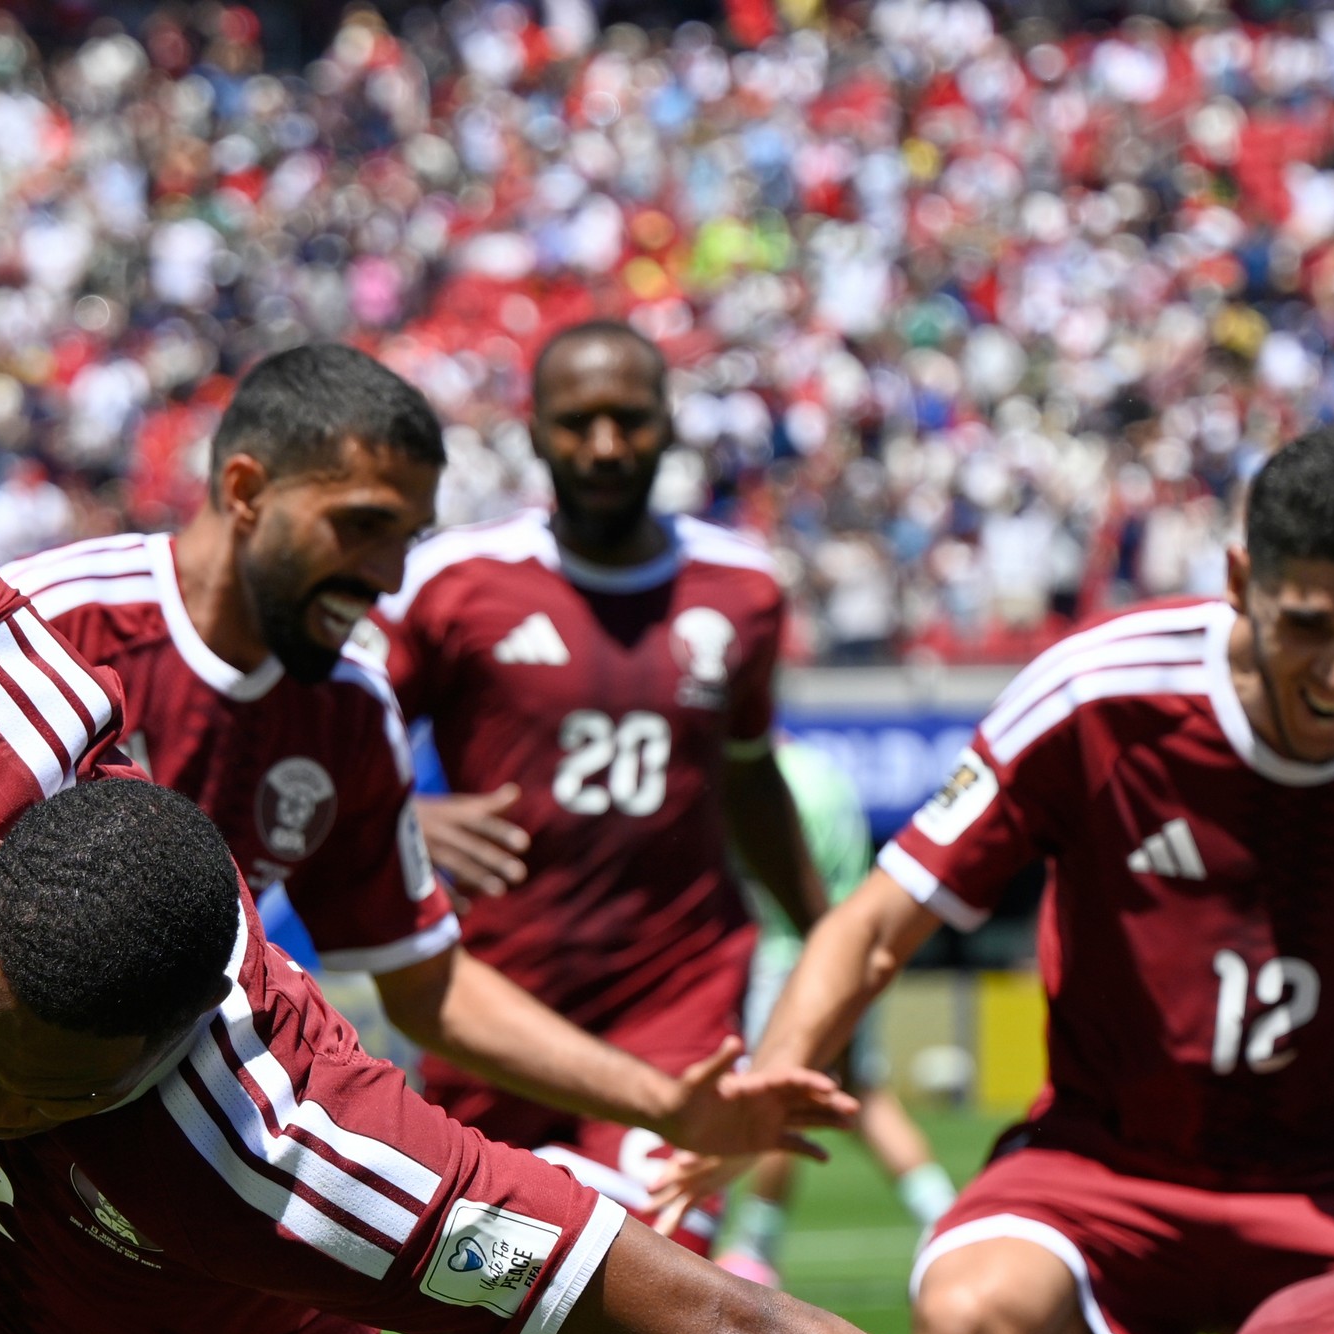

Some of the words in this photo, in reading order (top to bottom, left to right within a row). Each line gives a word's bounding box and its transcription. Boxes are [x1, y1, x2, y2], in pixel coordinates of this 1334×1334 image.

[552, 708, 672, 818] 20
[1211, 949, 1321, 1076] 12
[479, 1260, 504, 1291] Unite
[492, 1239, 510, 1260] For
[499, 1247, 533, 1290] PEACE
[523, 1264, 542, 1288] FIFA
